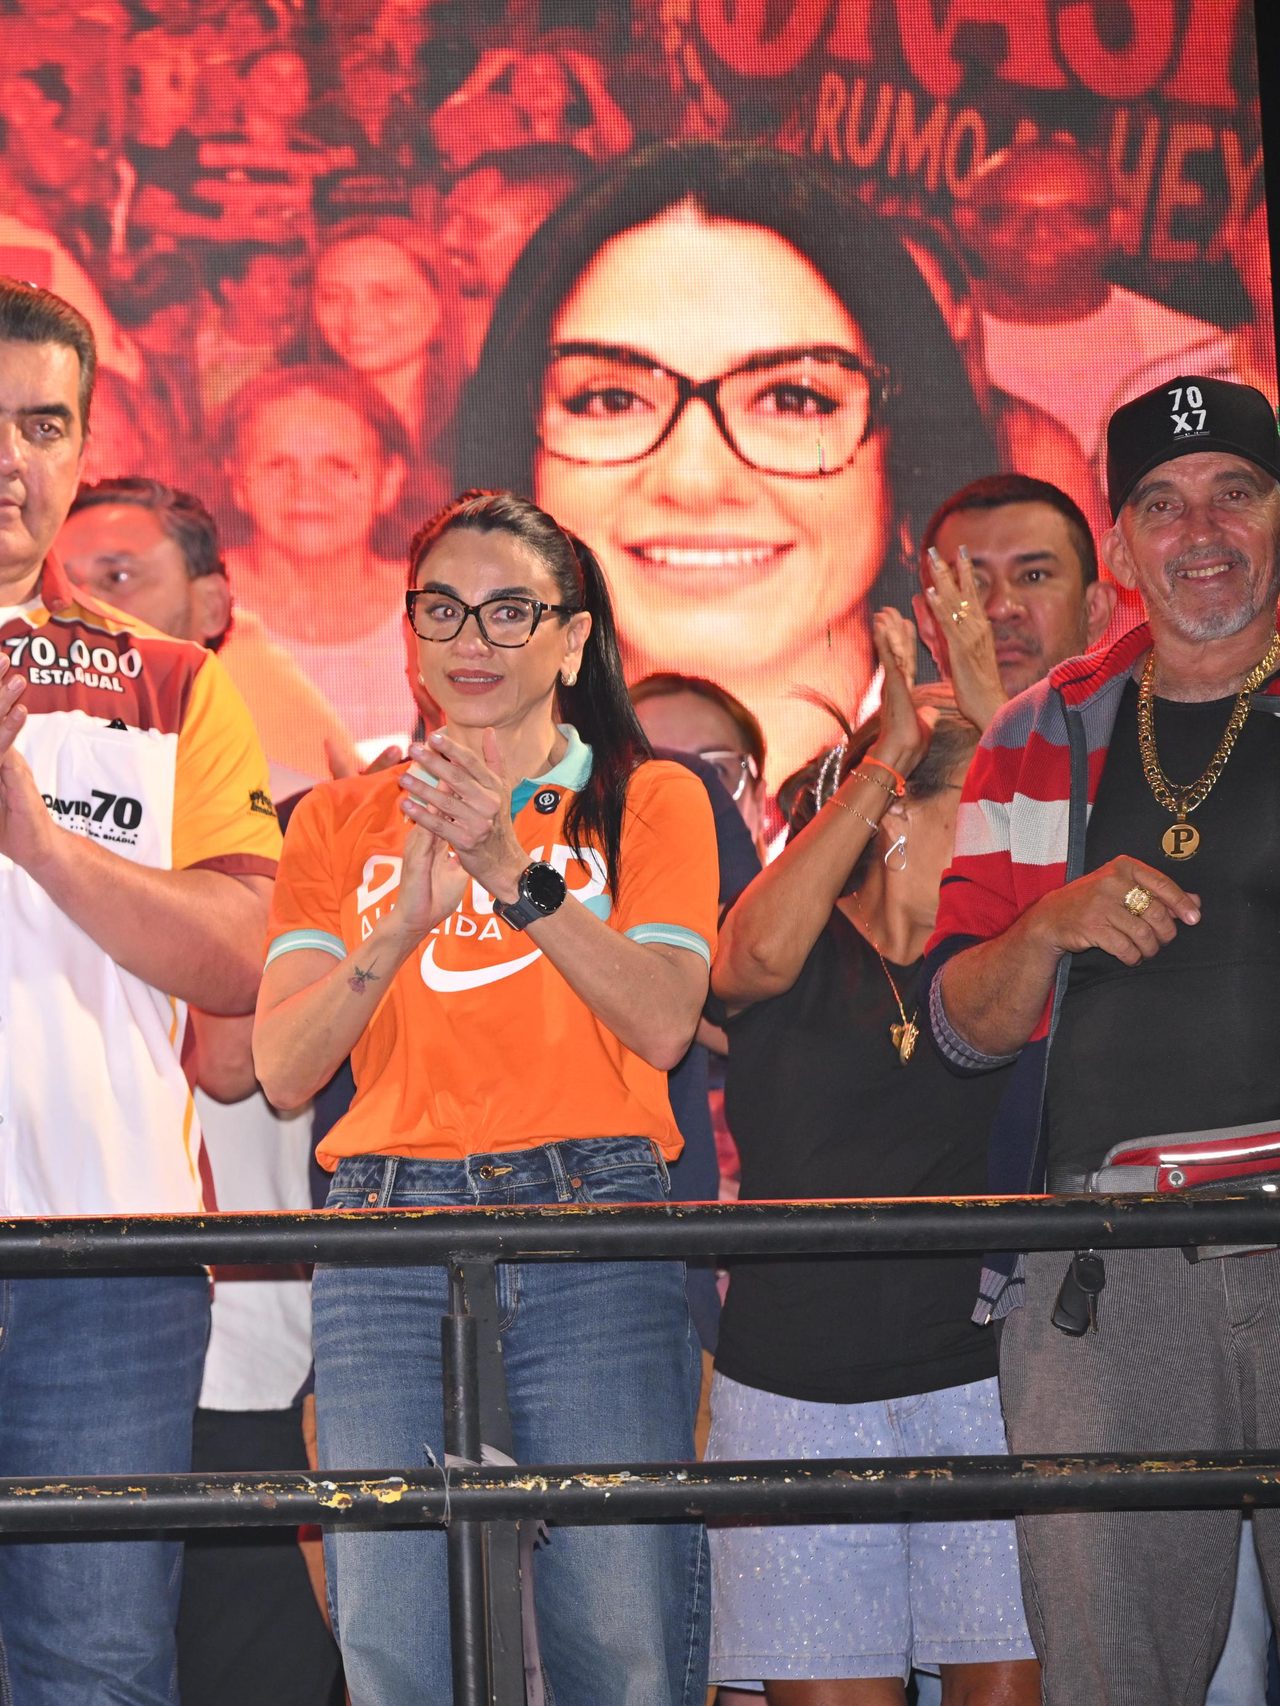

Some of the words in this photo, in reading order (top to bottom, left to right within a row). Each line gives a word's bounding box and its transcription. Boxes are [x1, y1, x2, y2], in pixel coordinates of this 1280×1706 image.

[814, 70, 987, 200] RUMO
[1168, 385, 1203, 412] 70
[4, 636, 143, 679] 70.000
[41, 794, 92, 818] DAVID
[91, 789, 143, 830] 70
[1170, 828, 1195, 855] P
